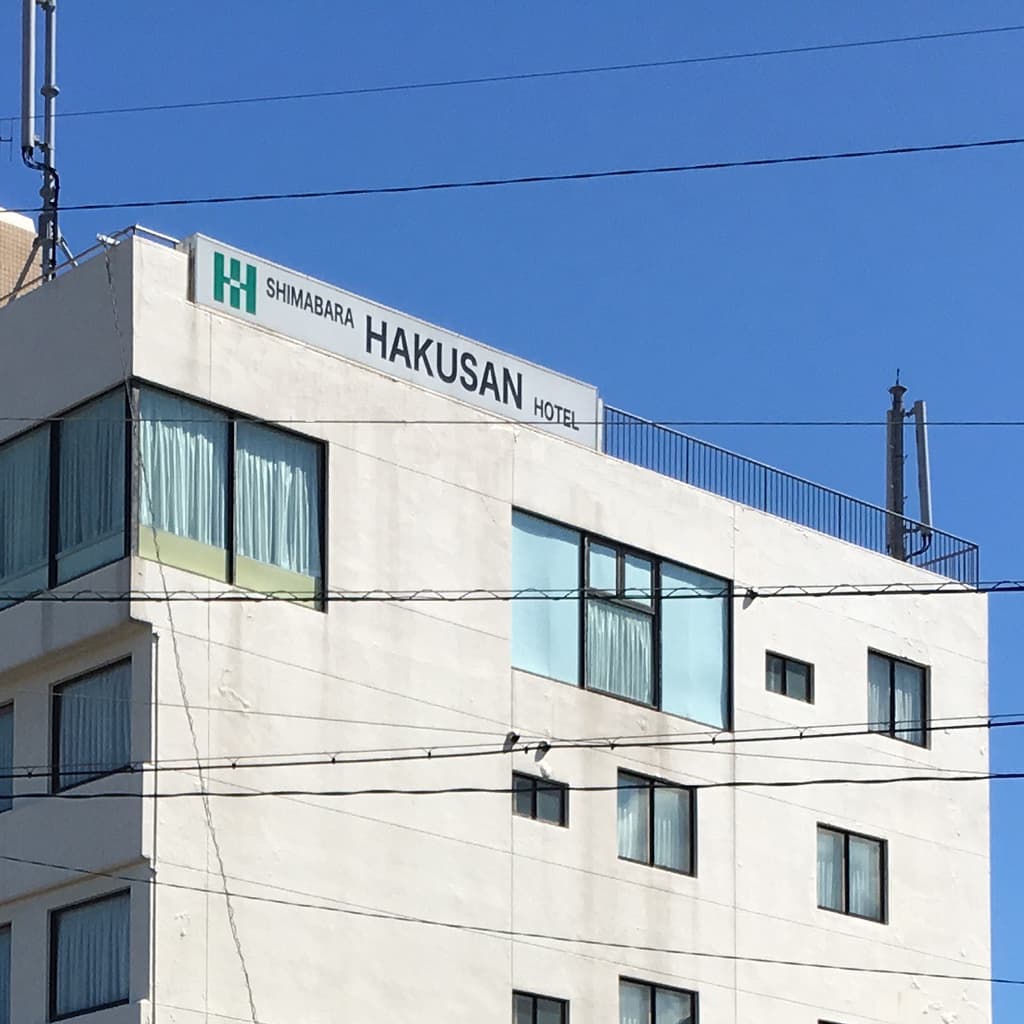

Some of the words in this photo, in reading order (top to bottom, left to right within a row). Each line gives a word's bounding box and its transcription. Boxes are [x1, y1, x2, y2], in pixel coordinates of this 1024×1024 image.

[266, 277, 355, 329] SHIMABARA
[366, 315, 523, 410] HAKUSAN
[534, 396, 580, 431] HOTEL
